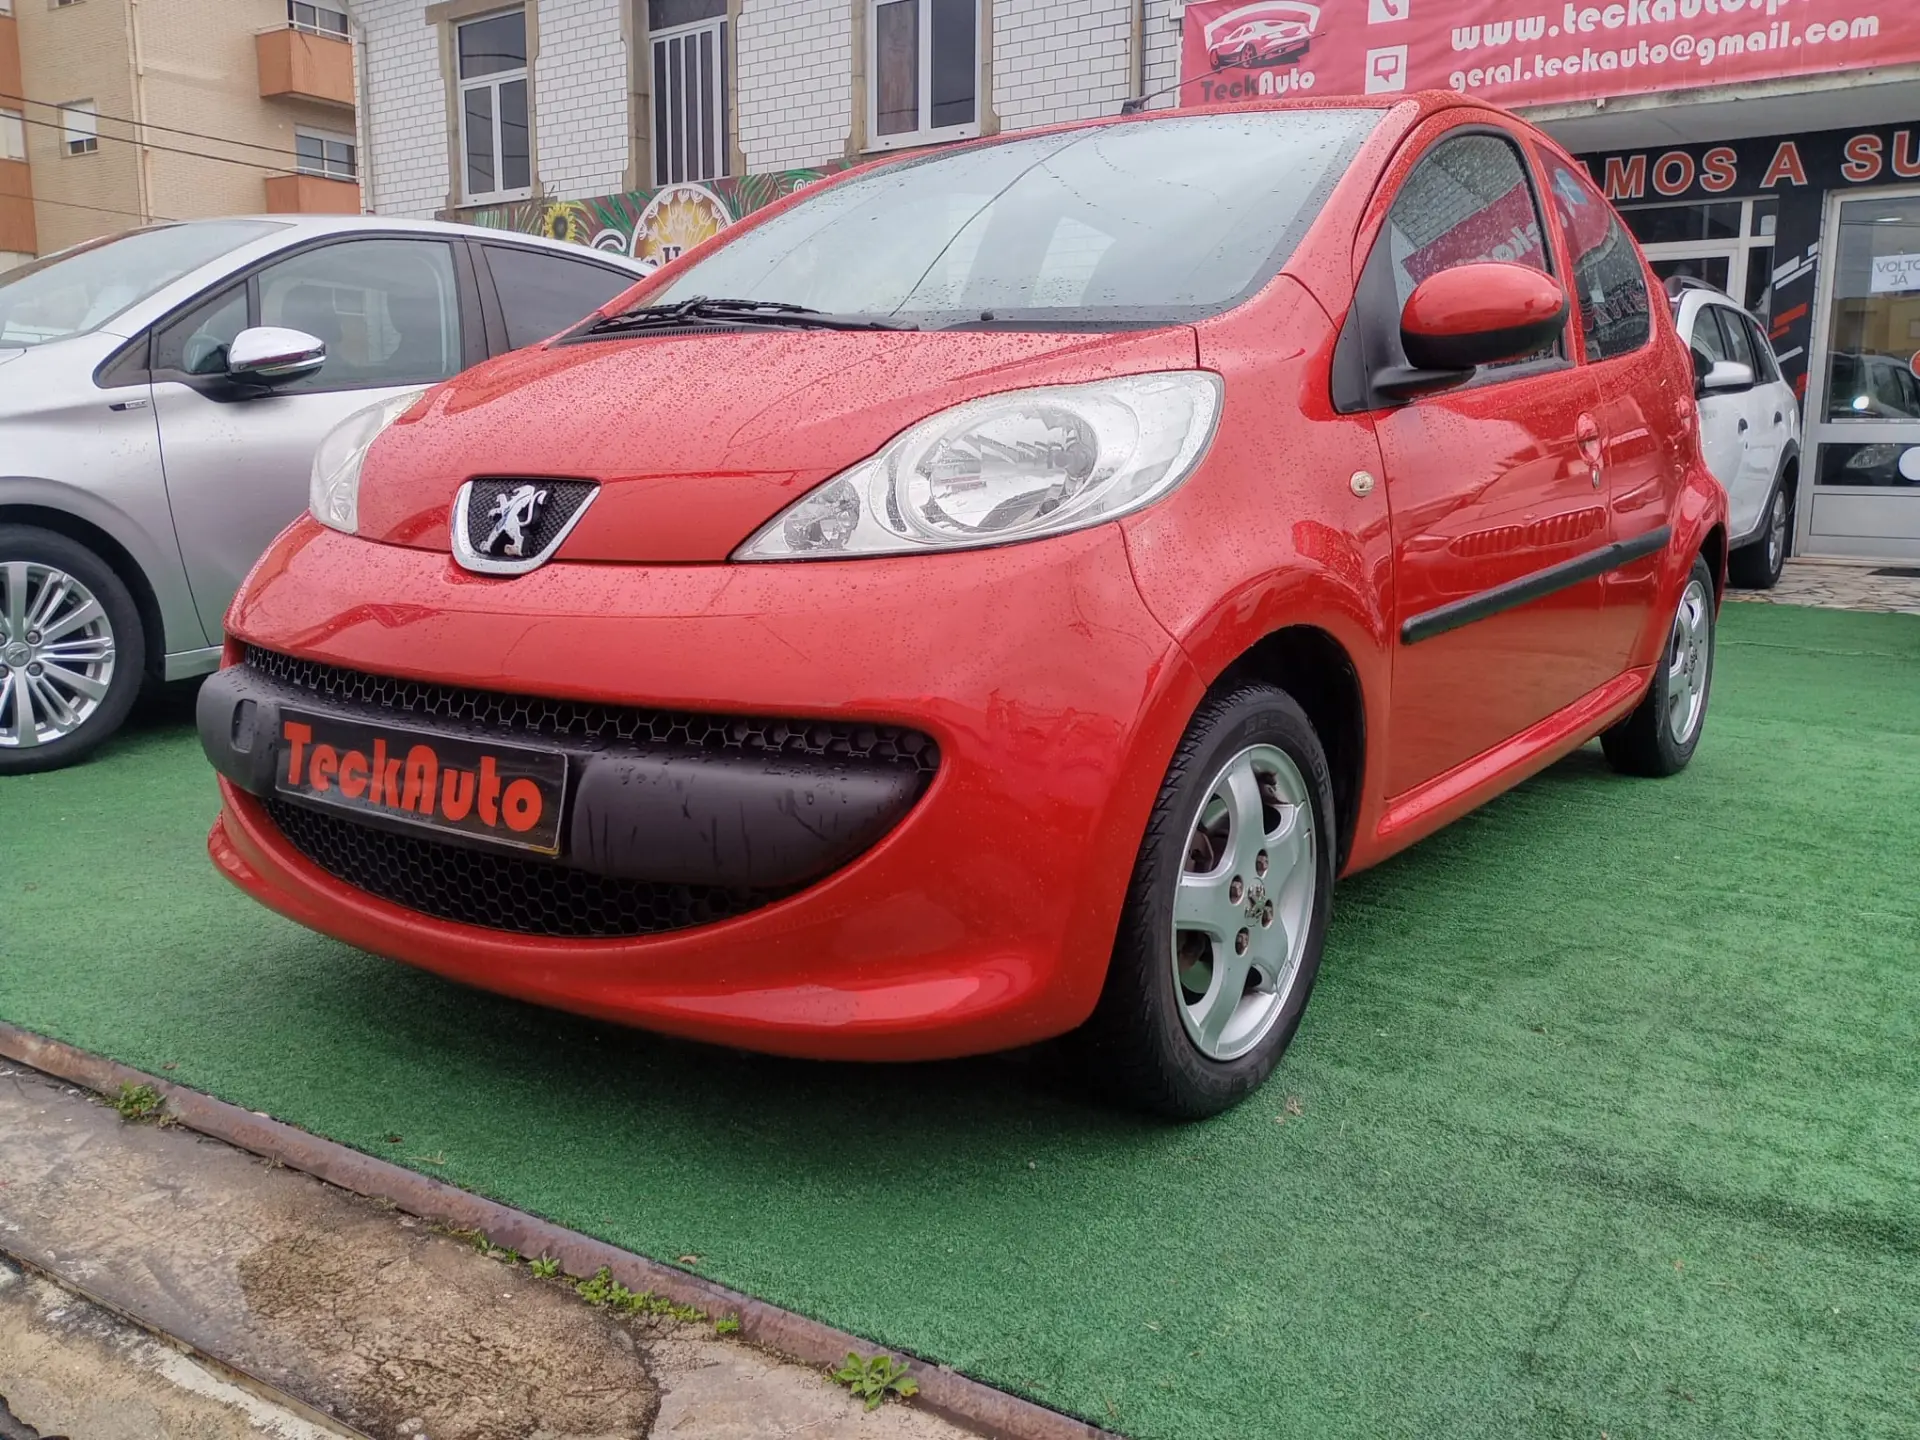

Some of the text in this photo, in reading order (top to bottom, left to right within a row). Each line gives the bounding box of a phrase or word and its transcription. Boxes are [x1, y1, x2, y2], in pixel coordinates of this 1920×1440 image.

[1449, 15, 1879, 93] geral.teckauto@gmail.com
[1202, 67, 1316, 103] TeckAuto
[1577, 147, 1738, 200] MOS
[1759, 141, 1808, 188] A
[1876, 260, 1920, 273] VOLTO
[1890, 271, 1909, 286] JÁ
[284, 721, 543, 832] TeckAuto
